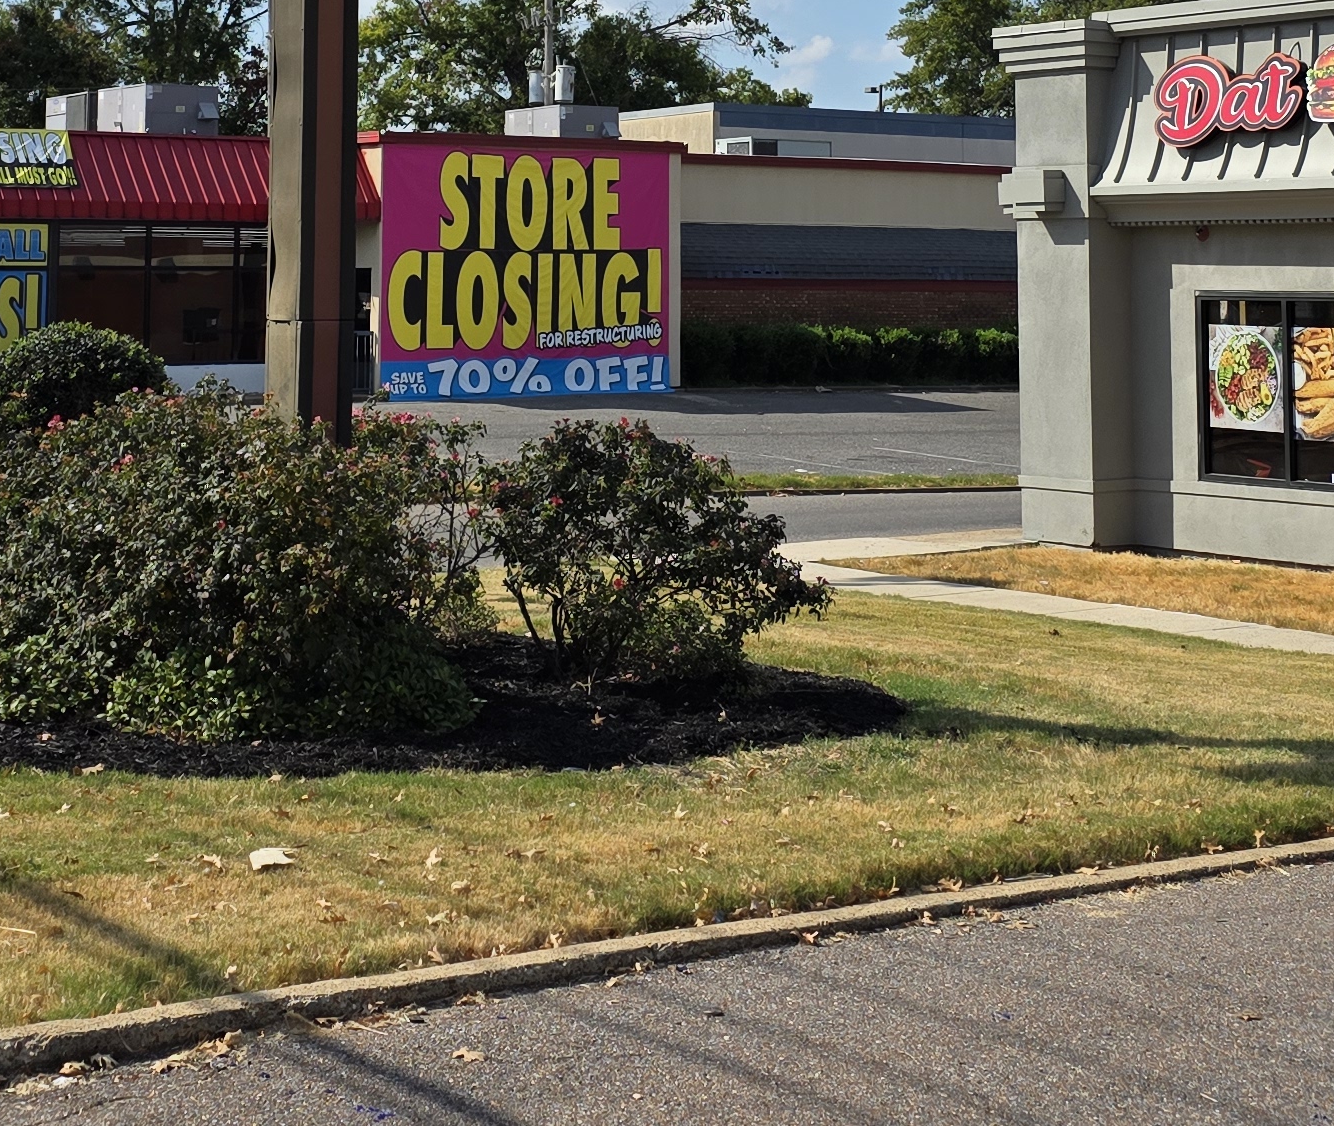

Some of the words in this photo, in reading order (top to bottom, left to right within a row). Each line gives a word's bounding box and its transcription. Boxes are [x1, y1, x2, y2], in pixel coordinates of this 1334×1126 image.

[1159, 59, 1297, 142] Dat
[15, 165, 47, 185] MUST
[438, 150, 622, 251] STORE
[387, 247, 662, 351] CLOSING!
[538, 331, 564, 350] FOR
[565, 322, 663, 348] RESTRUCTURING
[389, 384, 410, 395] UP
[410, 383, 427, 395] TO
[390, 371, 425, 384] SAVE
[427, 356, 552, 397] 70%
[564, 355, 667, 393] OFF!
